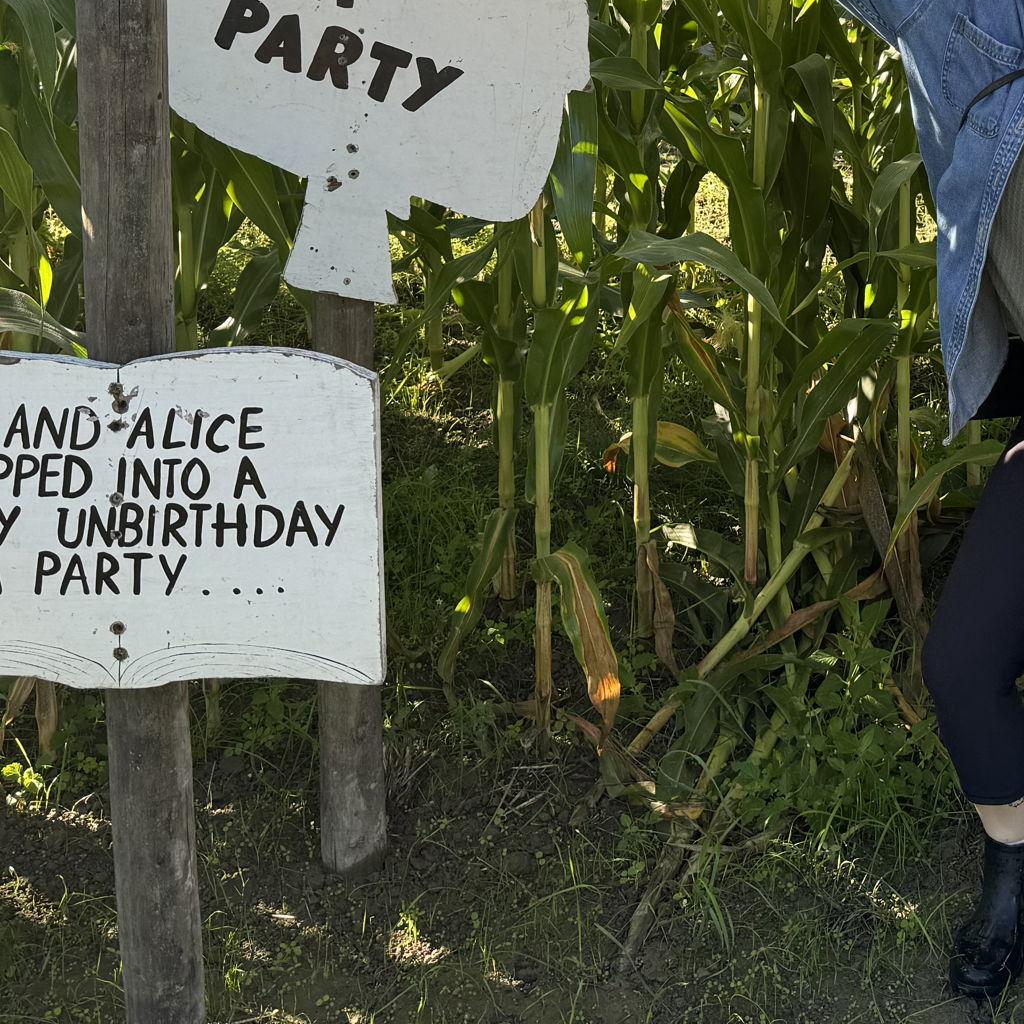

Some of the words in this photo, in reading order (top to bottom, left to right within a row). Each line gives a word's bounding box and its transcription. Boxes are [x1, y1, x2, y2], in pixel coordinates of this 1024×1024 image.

[3, 403, 101, 450] AND
[126, 406, 266, 453] ALICE
[117, 457, 211, 501] INTO
[233, 456, 267, 499] A
[57, 500, 346, 549] UNBIRTHDAY
